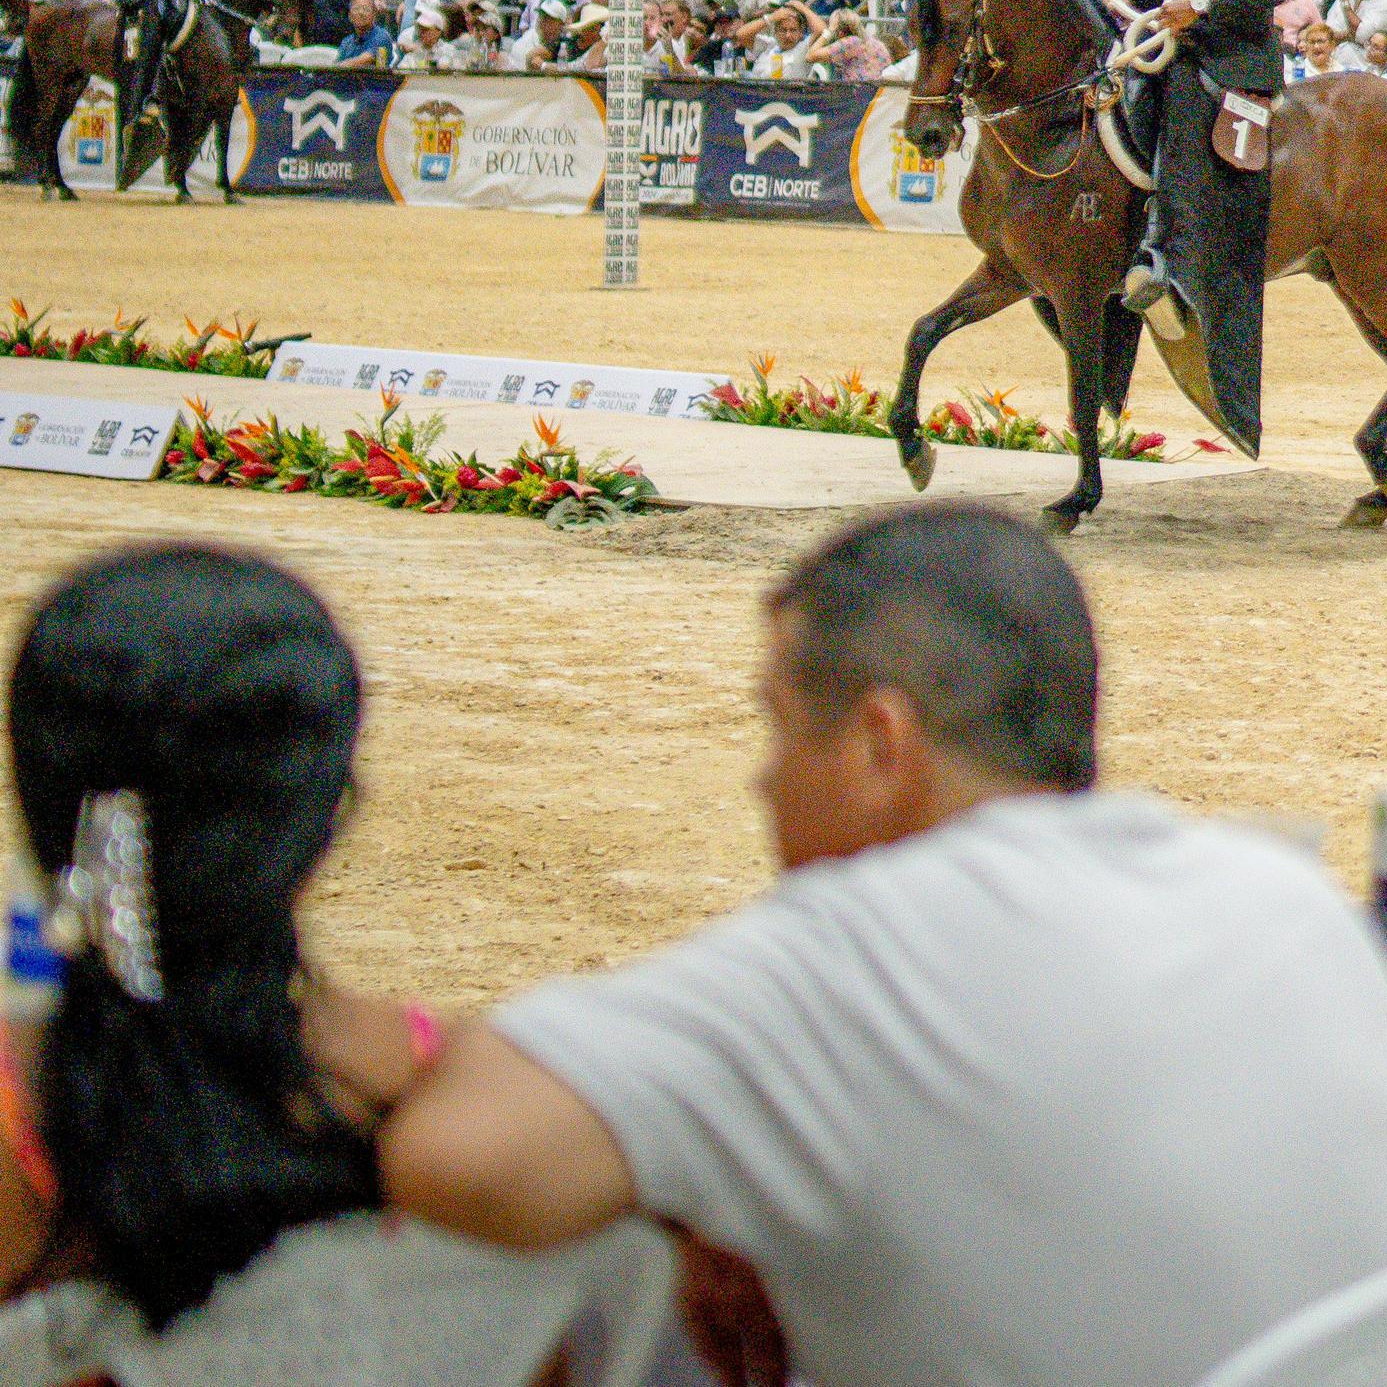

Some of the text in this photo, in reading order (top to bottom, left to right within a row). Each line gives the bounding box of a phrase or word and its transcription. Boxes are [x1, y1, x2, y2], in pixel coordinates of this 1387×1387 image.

[472, 124, 578, 146] GOBERNACIÓN
[641, 99, 702, 154] AGRO
[278, 157, 353, 180] CEB NORTE
[484, 149, 576, 179] BOLÍVAR
[729, 173, 821, 201] CEB NORTE
